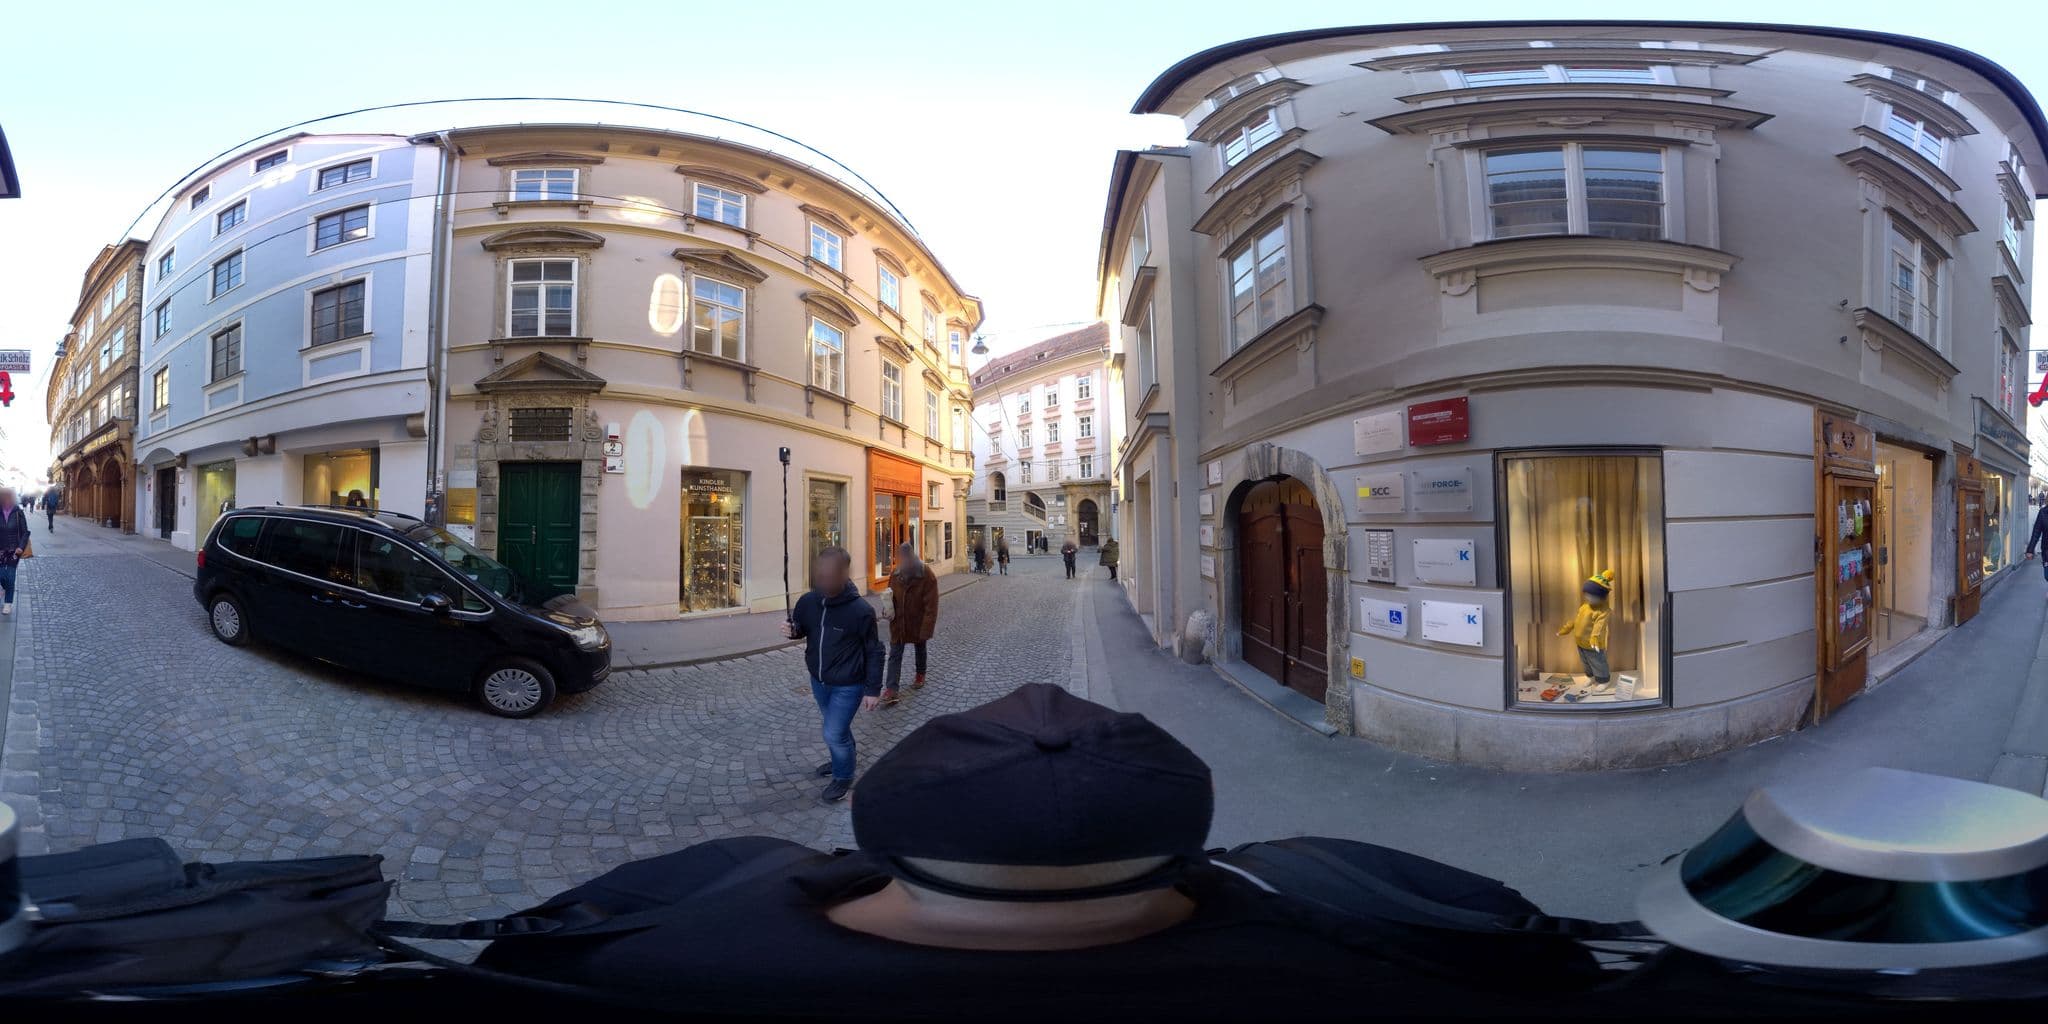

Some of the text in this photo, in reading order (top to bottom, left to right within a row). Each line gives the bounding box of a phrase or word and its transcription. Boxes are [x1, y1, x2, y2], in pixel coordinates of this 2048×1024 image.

[609, 442, 616, 452] 2
[699, 478, 725, 486] KINDLER
[689, 484, 733, 493] KUNSTHANDEL
[1371, 486, 1390, 496] SCC
[1459, 550, 1470, 561] K
[1467, 614, 1478, 625] K
